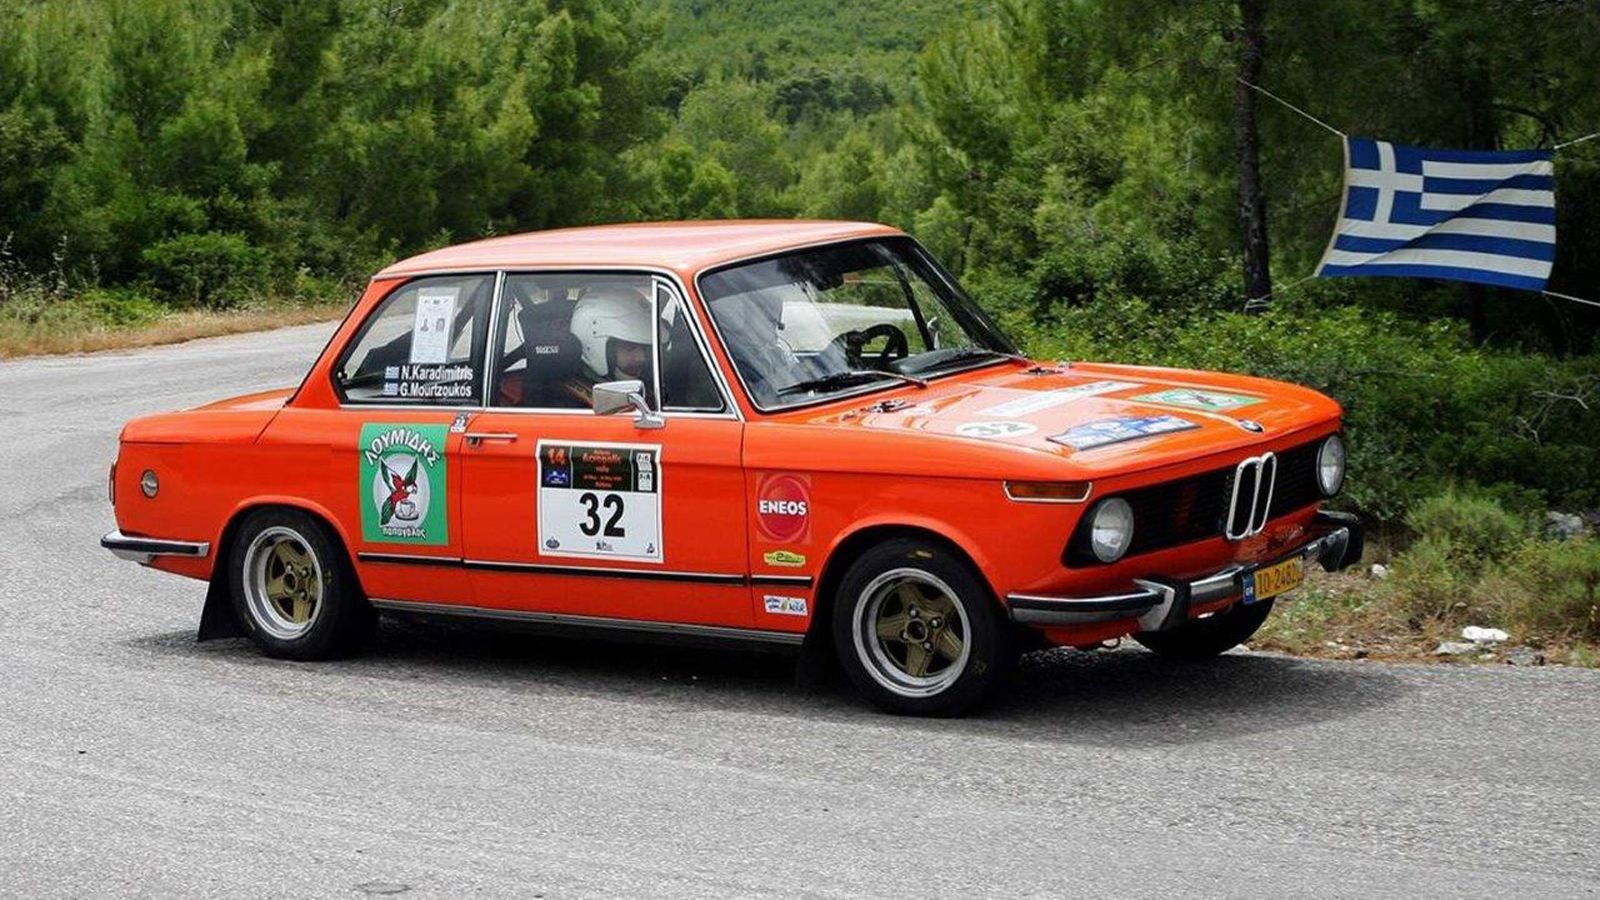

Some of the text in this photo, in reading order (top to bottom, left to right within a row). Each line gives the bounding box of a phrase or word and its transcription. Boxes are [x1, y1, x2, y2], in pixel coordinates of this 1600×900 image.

[364, 428, 440, 467] ΛΟΥΜΙΔΗΣ
[579, 492, 625, 537] 32
[759, 500, 807, 516] ENEOS
